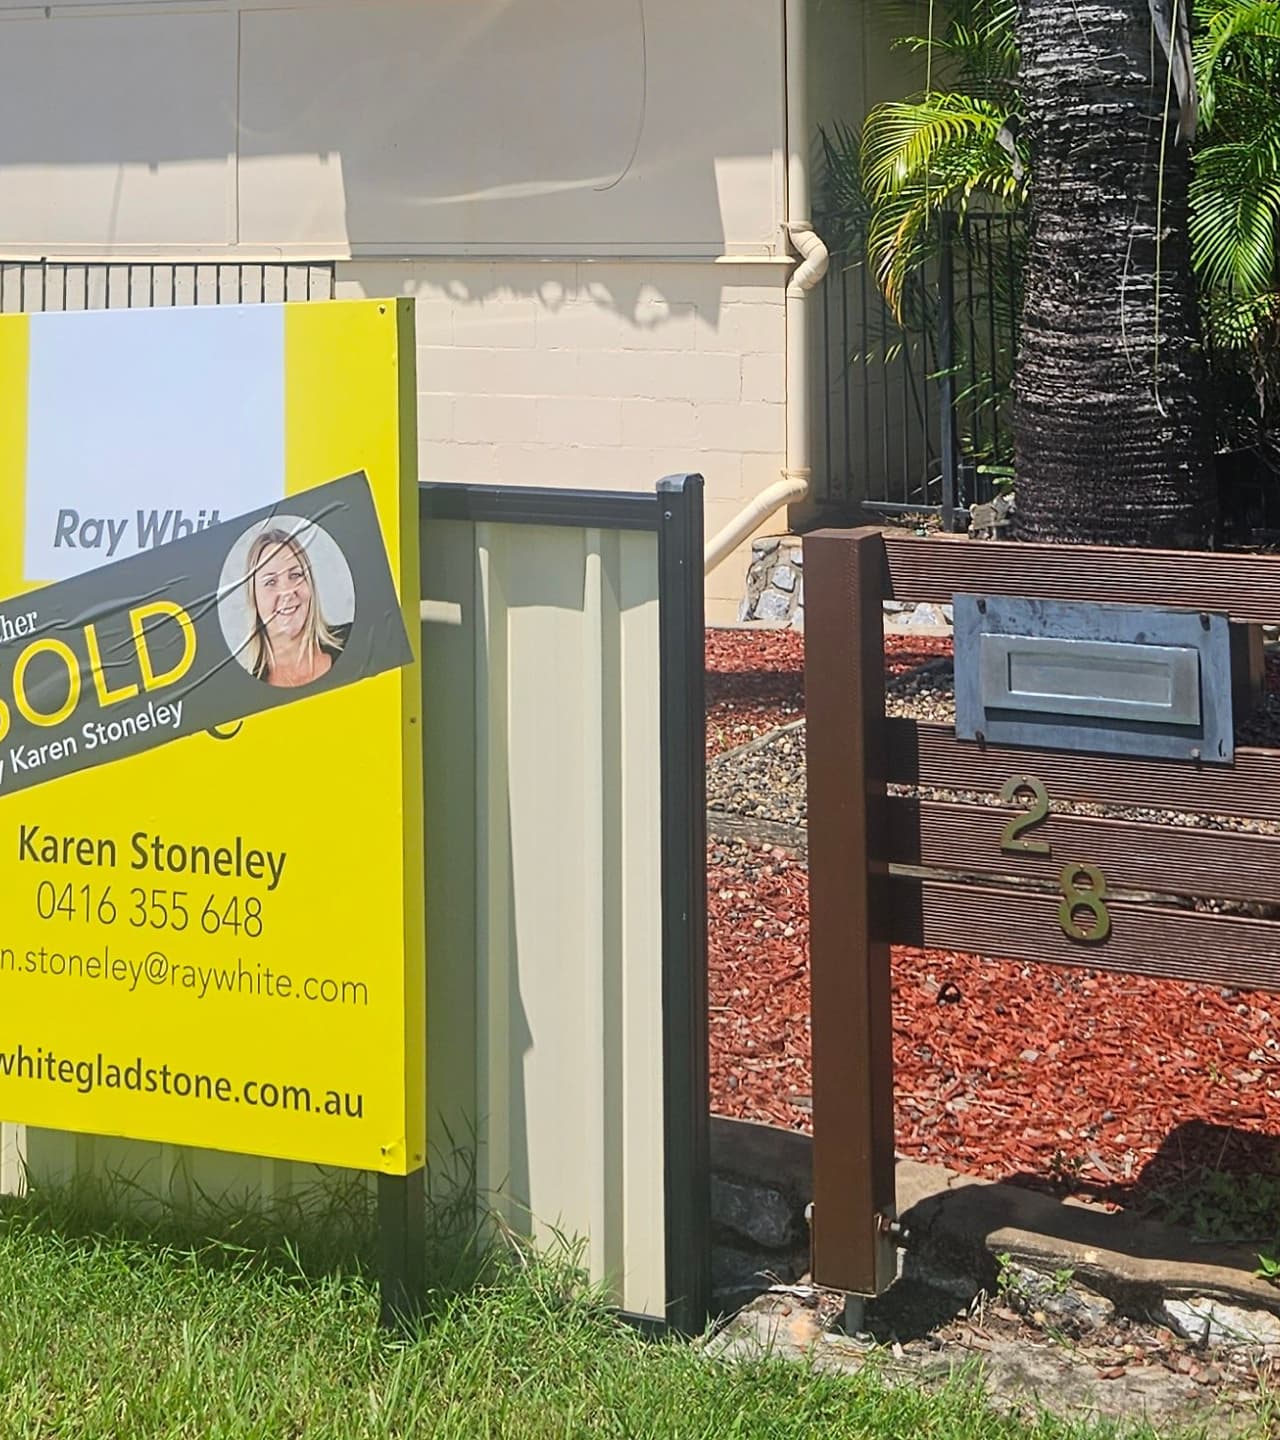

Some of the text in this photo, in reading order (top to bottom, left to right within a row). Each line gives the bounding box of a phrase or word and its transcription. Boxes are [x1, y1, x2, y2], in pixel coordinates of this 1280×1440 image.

[54, 509, 222, 557] Ray Whit
[10, 736, 78, 773] Karen
[82, 700, 184, 750] Stoneley
[19, 825, 286, 890] Karen Stoneley
[36, 880, 263, 938] 0416 355 648
